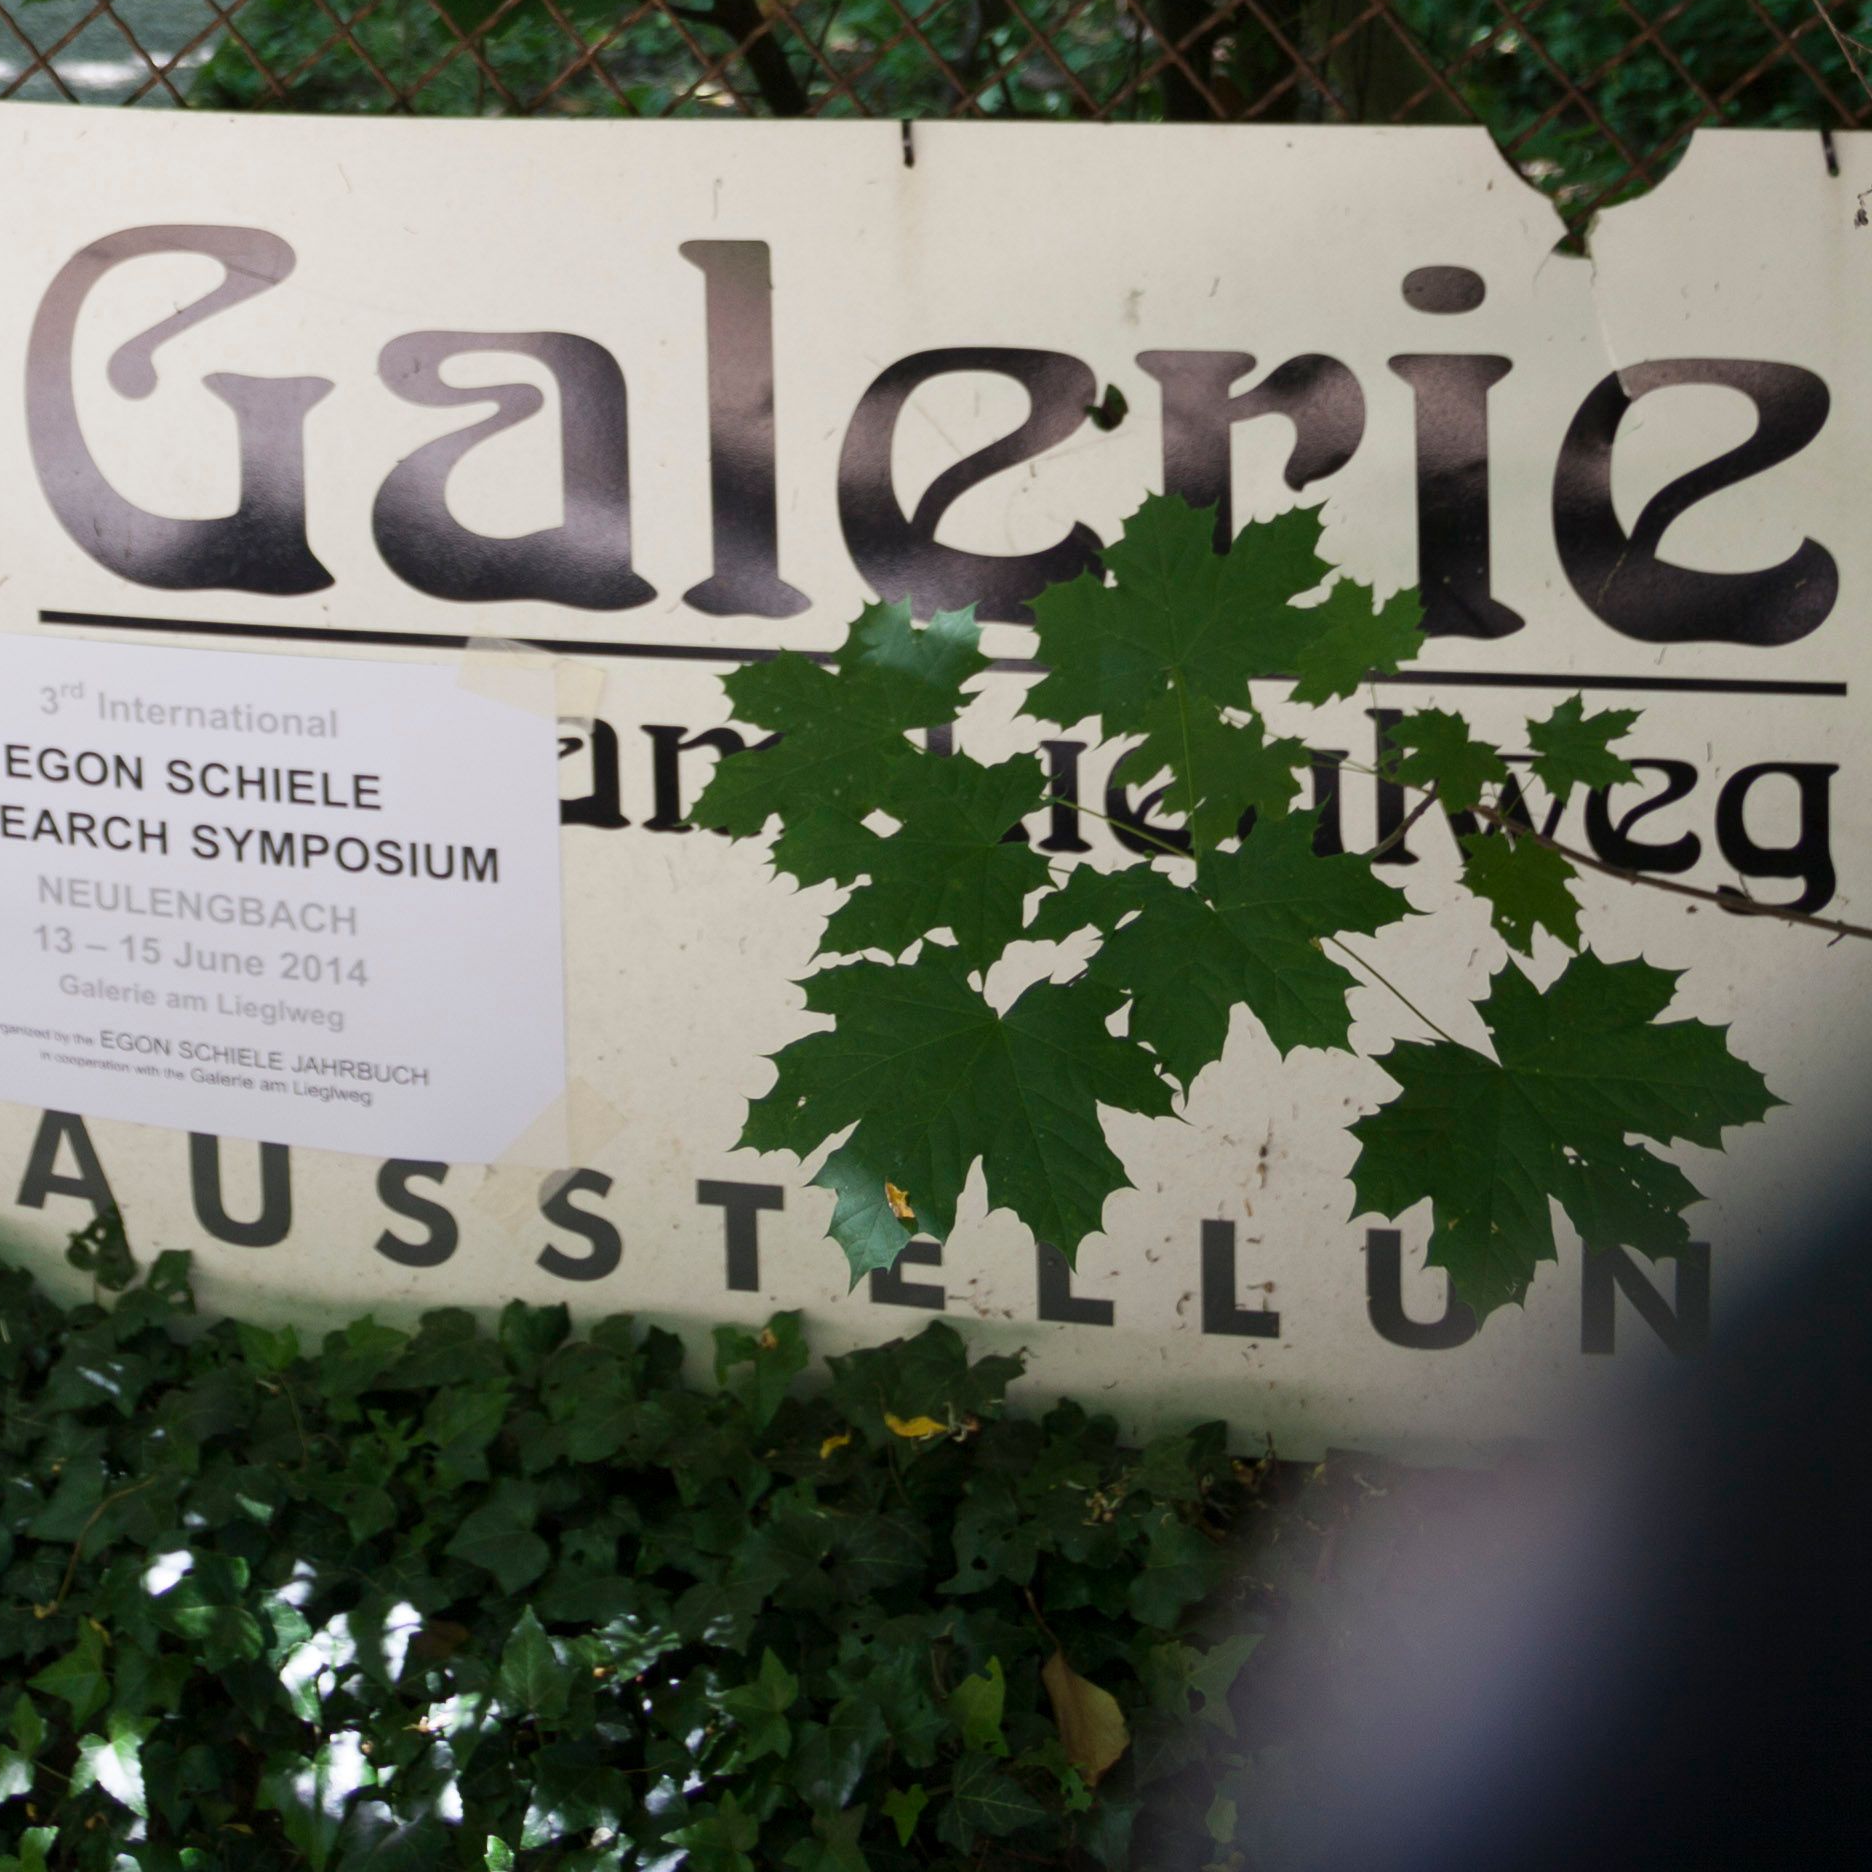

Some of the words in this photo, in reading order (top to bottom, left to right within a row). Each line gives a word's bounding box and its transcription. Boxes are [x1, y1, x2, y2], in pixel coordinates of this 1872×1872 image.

[24, 222, 1839, 647] Galerie
[96, 691, 339, 739] International
[3, 743, 145, 791] EGON
[165, 758, 383, 811] SCHIELE
[190, 823, 502, 884] SYMPOSIUM
[36, 874, 359, 937] NEULENGBACH
[33, 925, 75, 955] 13
[119, 934, 162, 966] 15
[172, 941, 266, 978] June
[280, 952, 369, 988] 2014
[59, 973, 157, 1008] Galerie
[165, 991, 209, 1014] am
[216, 993, 346, 1033] Lieglweg
[72, 1032, 94, 1046] the
[99, 1029, 171, 1057] EGON
[177, 1040, 284, 1071] SCHIELE
[290, 1054, 431, 1087] JAHRBUCH
[134, 1062, 160, 1077] with
[162, 1066, 185, 1081] the
[190, 1067, 254, 1091] Galerie
[259, 1078, 288, 1094] am
[293, 1080, 373, 1107] Lieglweg
